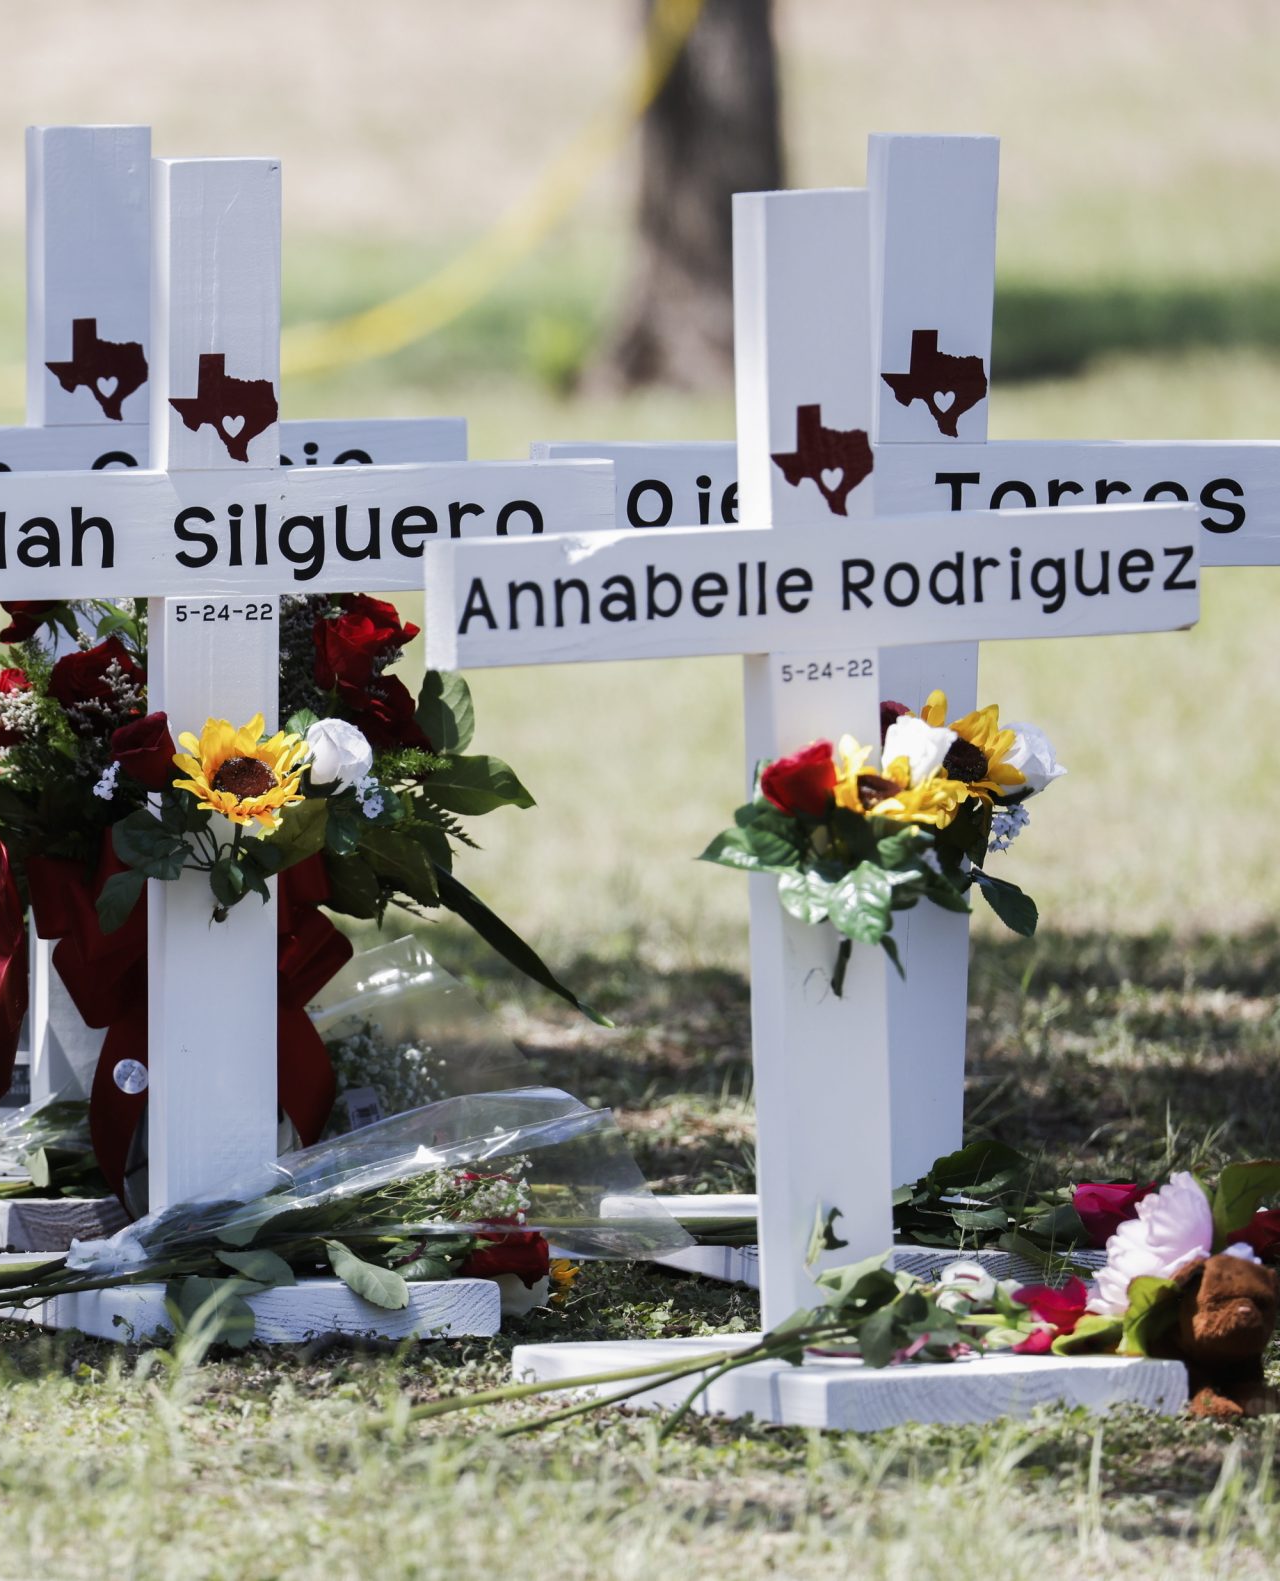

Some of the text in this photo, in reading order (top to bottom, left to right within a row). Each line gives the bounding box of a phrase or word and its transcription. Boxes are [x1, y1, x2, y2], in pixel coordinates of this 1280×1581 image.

[173, 499, 544, 582] Silguero
[175, 603, 273, 623] 5-24-22
[457, 545, 1197, 635] Annabelle Rodriguez
[782, 658, 873, 683] 5-24-22
